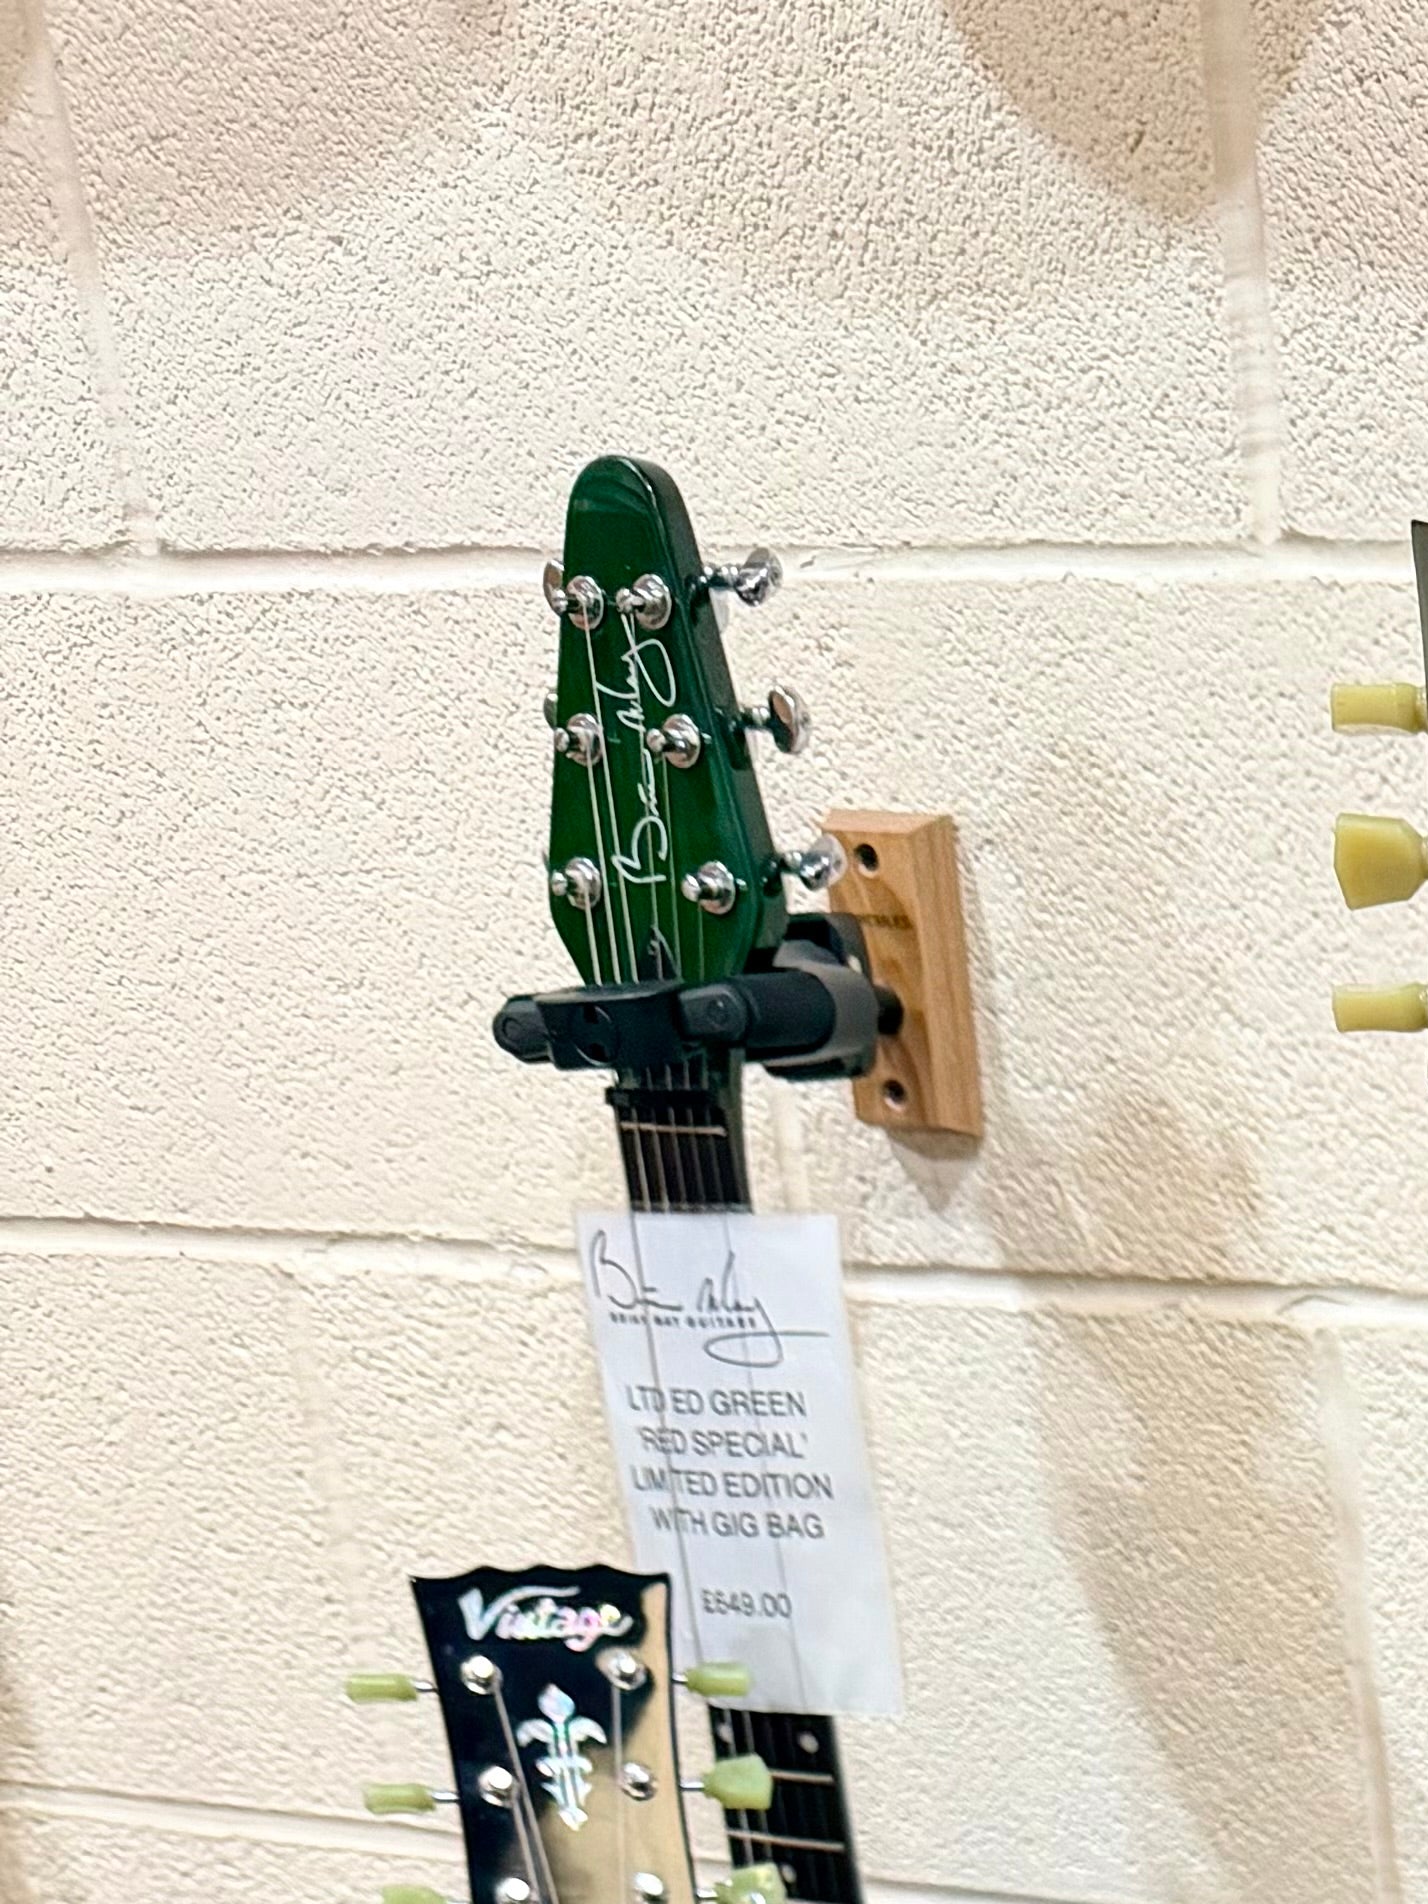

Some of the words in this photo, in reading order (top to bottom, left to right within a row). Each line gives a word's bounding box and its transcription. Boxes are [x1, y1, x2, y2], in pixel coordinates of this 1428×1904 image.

[669, 1387, 705, 1416] ED
[708, 1388, 808, 1418] GREEN
[630, 1464, 718, 1497] LIMITED
[722, 1471, 835, 1500] EDITION
[650, 1506, 708, 1535] WITH
[711, 1509, 761, 1538] GIG
[764, 1512, 826, 1540] BAG
[458, 1586, 634, 1652] Vintage
